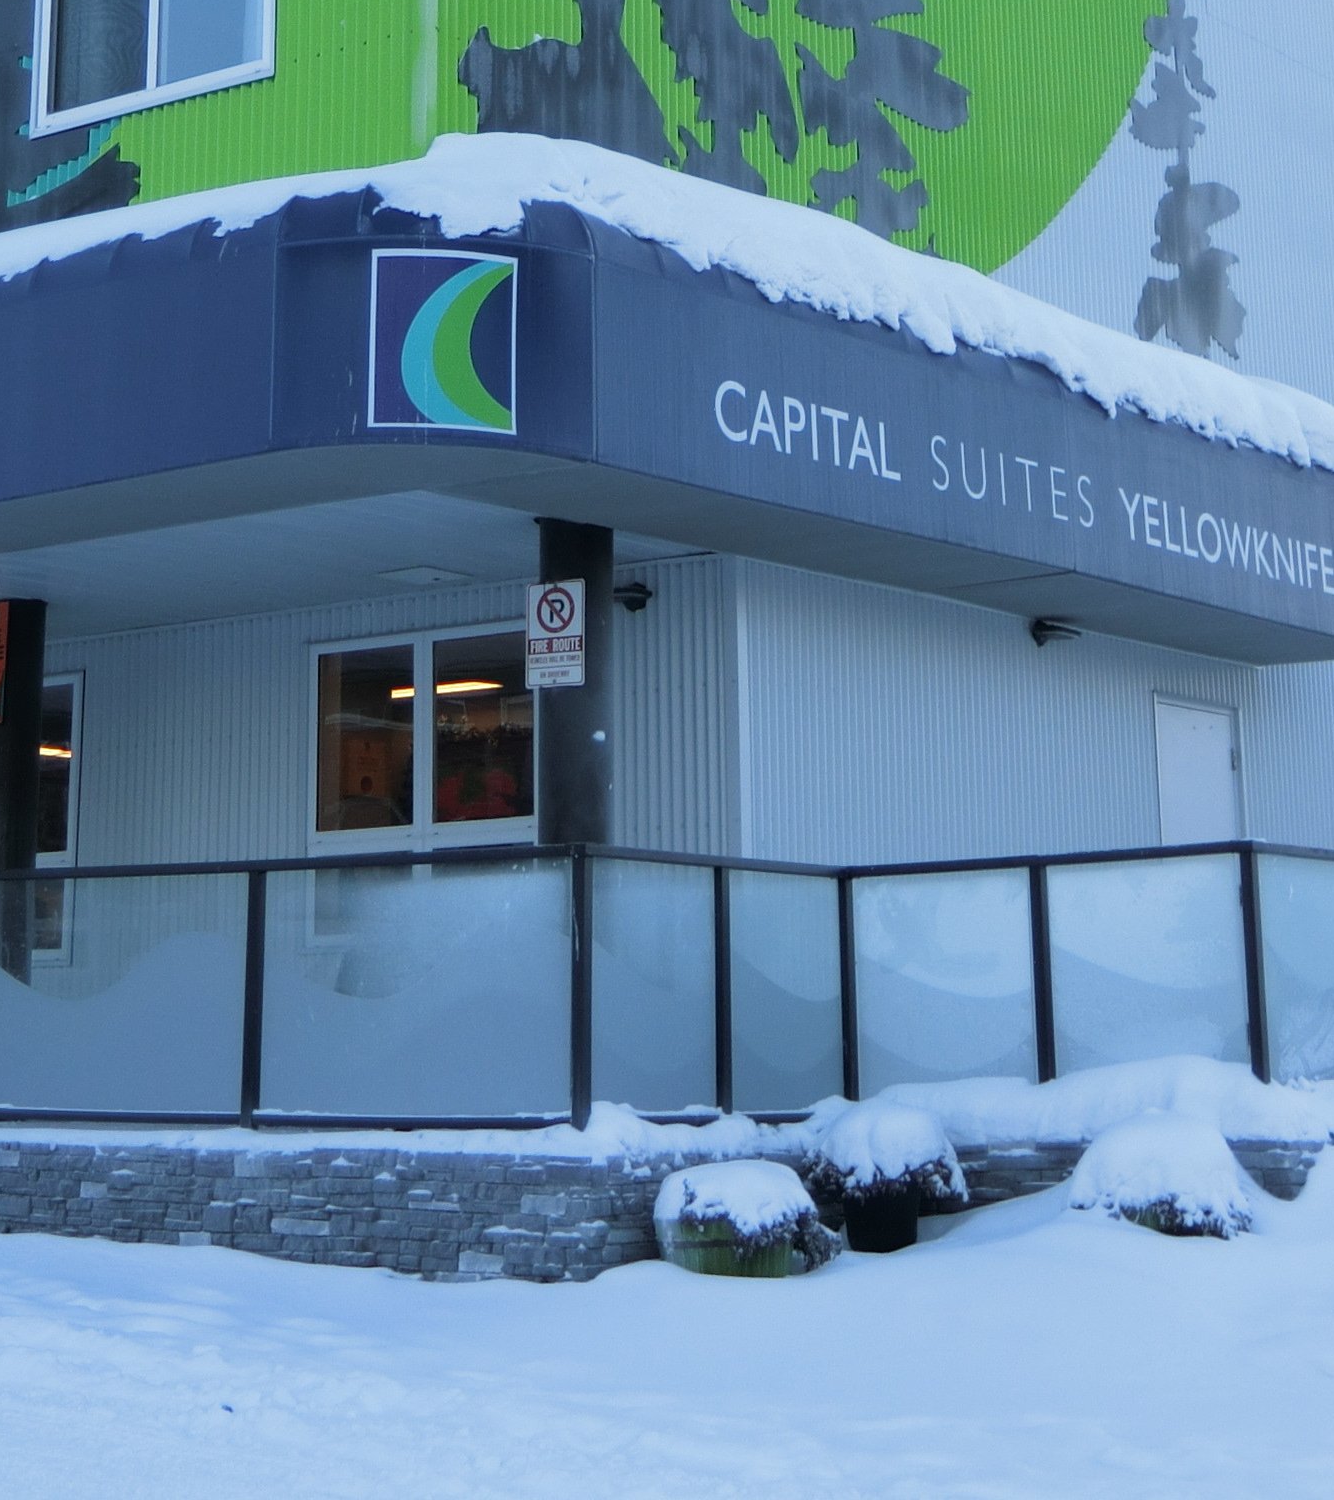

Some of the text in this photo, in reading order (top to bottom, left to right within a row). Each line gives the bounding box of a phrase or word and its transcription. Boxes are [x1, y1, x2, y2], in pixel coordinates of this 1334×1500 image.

[714, 380, 901, 481] CAPITAL
[931, 434, 1095, 528] SUITES
[530, 636, 581, 654] FIRE ROUTE
